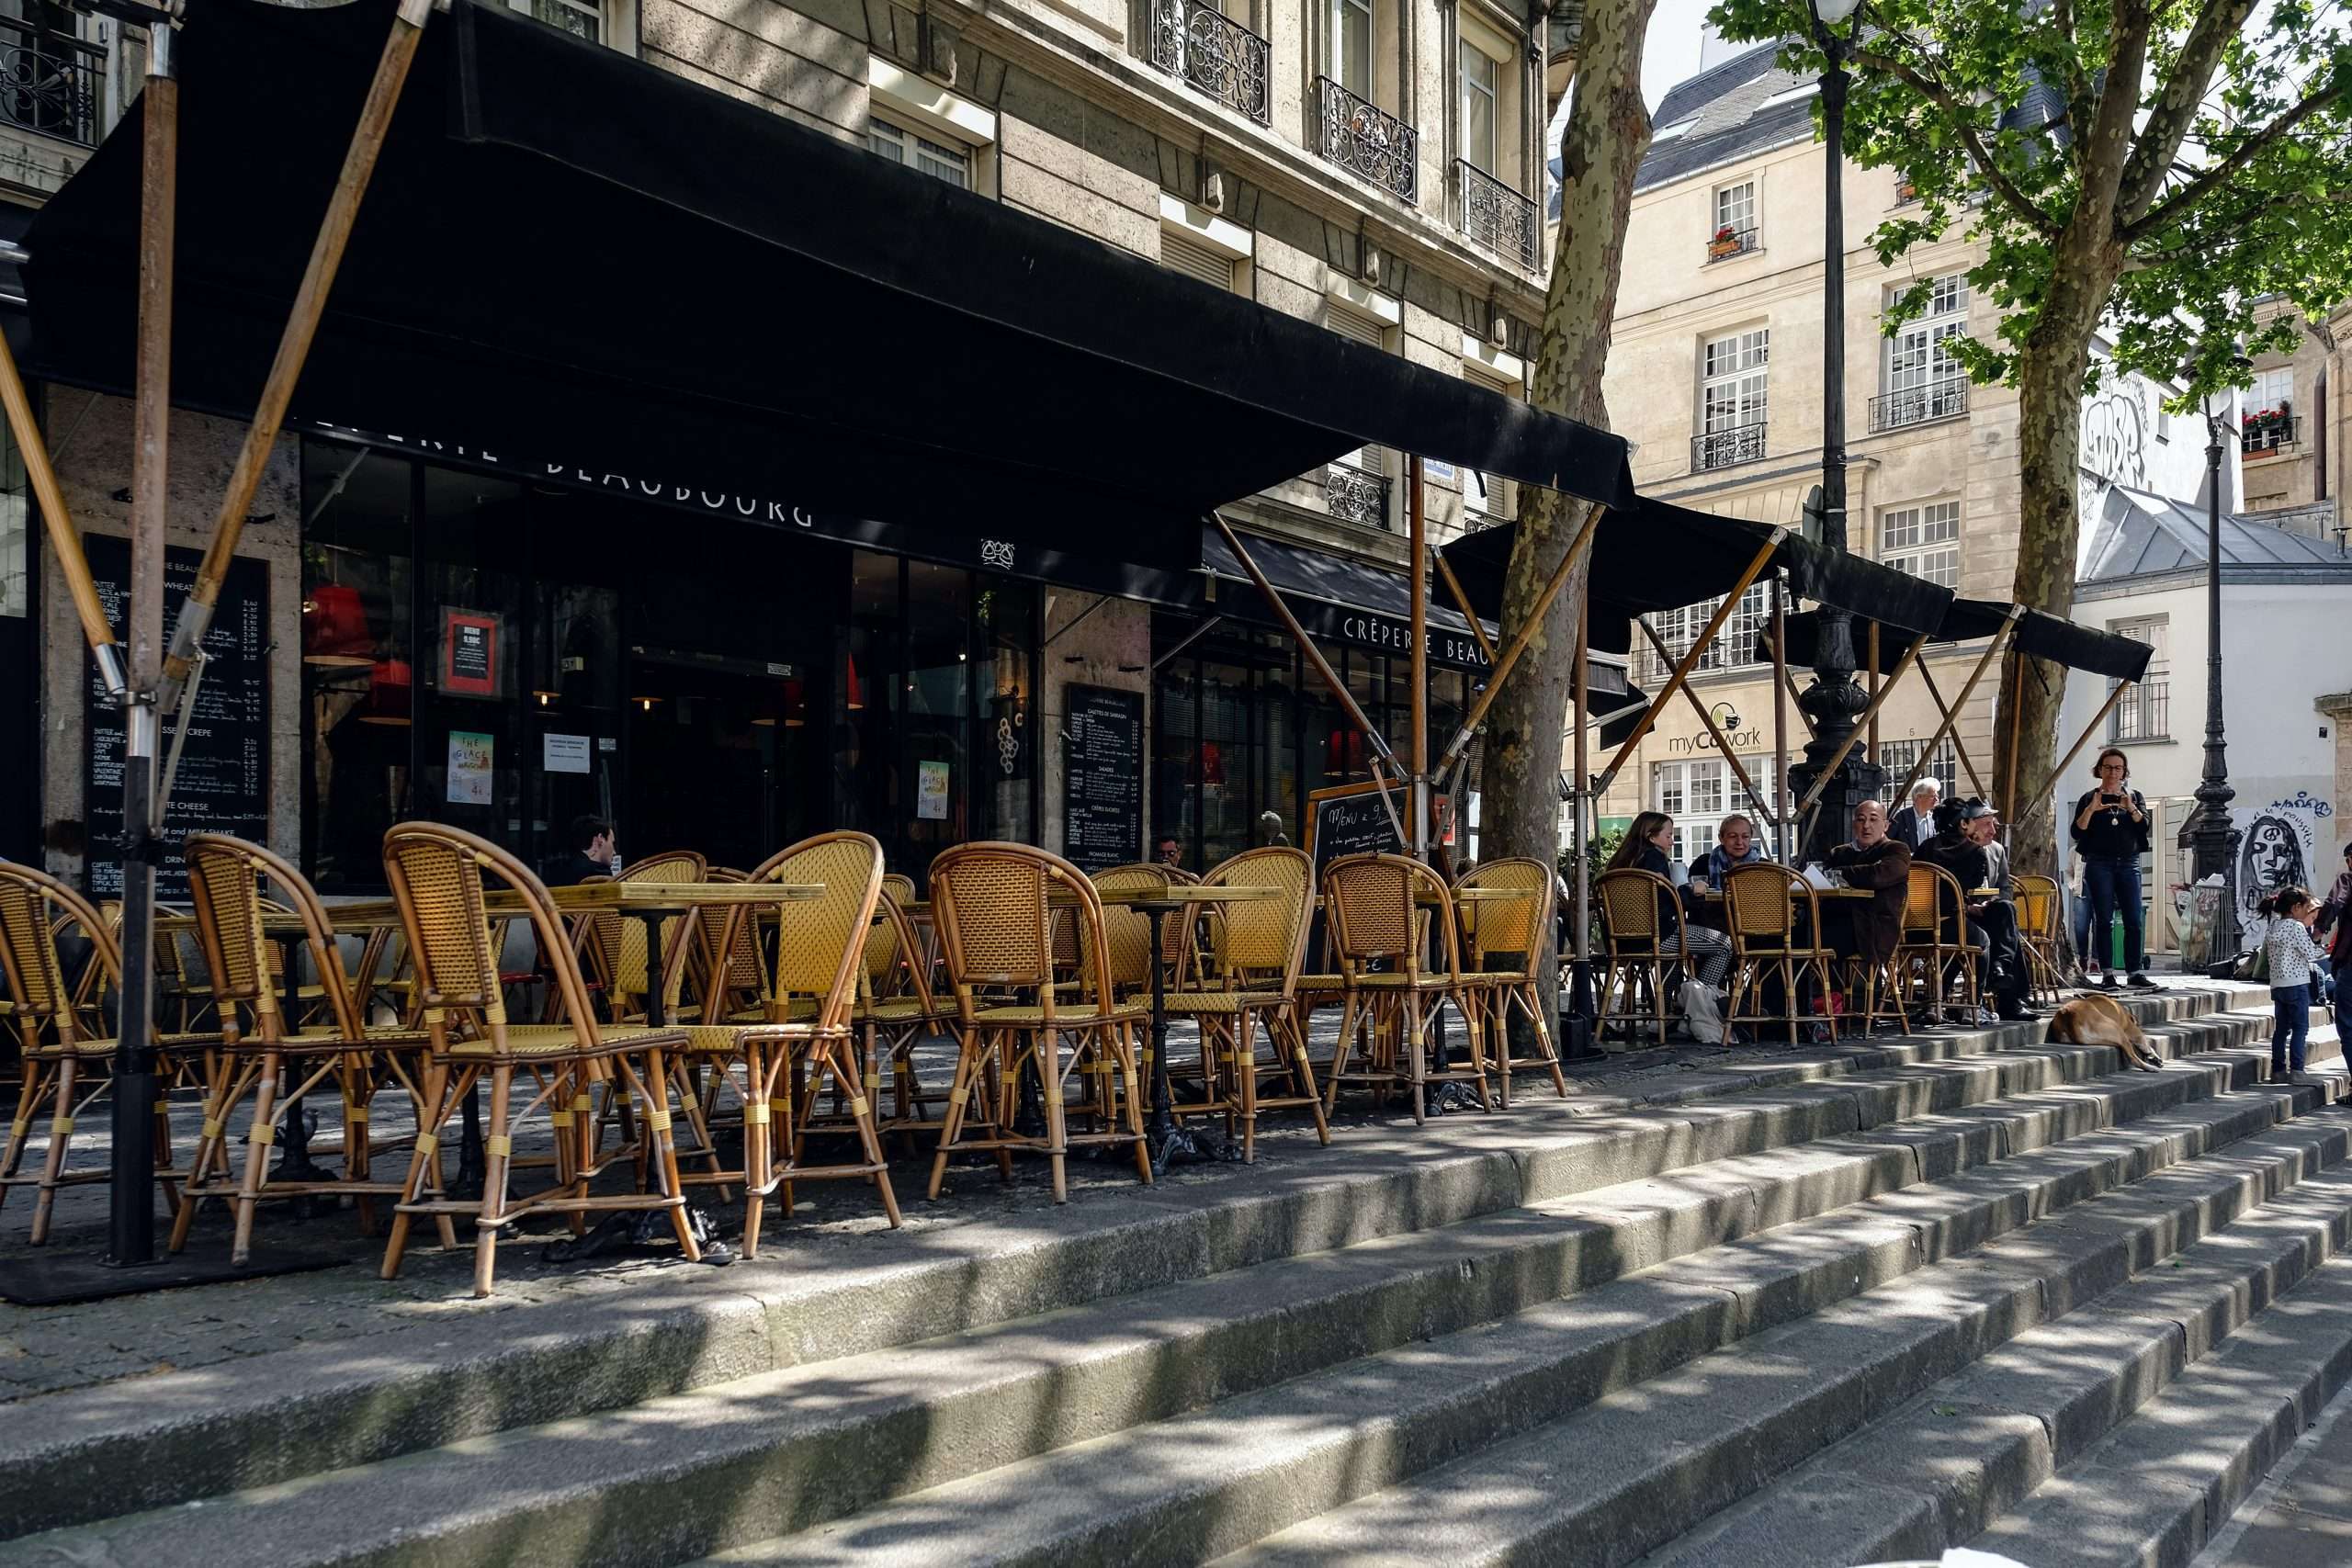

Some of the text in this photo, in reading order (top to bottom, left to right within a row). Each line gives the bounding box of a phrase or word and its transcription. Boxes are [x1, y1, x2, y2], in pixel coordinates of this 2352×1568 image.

[1343, 617, 1488, 666] CRÊPERE BEAU
[177, 803, 210, 811] CHEESE
[165, 855, 186, 864] DRIN
